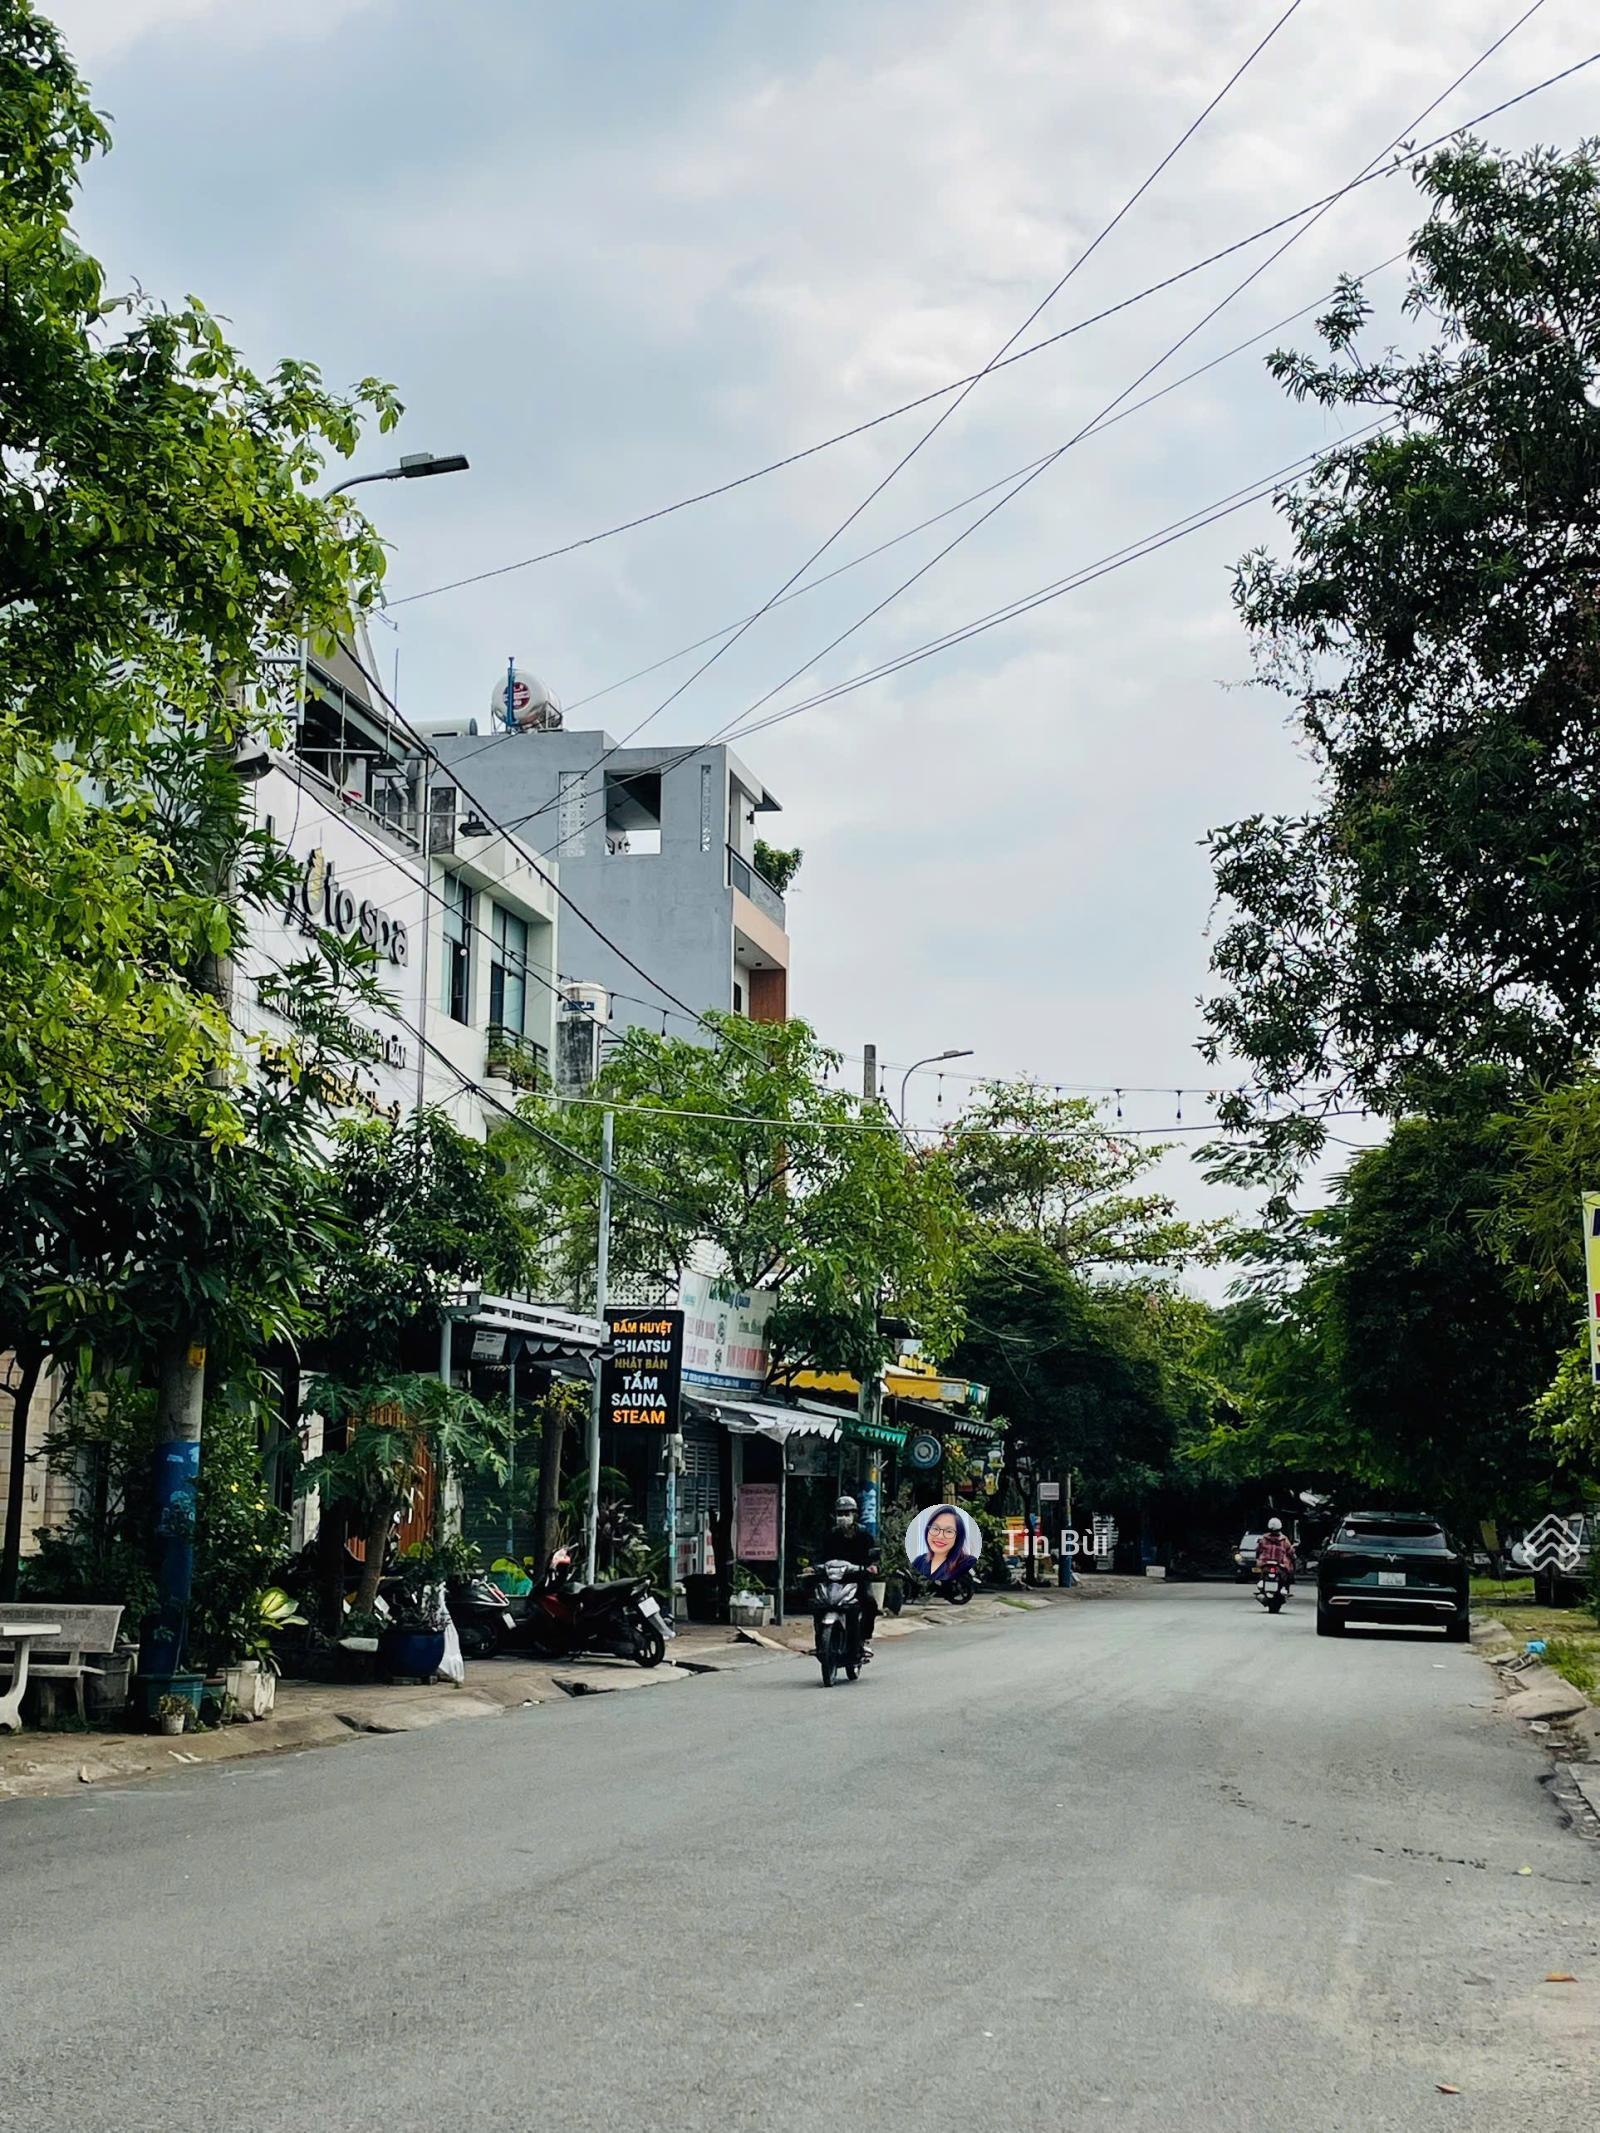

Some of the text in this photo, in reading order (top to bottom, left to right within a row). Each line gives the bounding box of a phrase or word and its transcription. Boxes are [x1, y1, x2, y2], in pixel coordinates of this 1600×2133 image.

[613, 1318, 637, 1333] BẤM
[639, 1320, 673, 1336] HUYỆT
[613, 1339, 671, 1353] SHIATSU
[614, 1356, 643, 1371] NHẬT
[645, 1355, 668, 1370] BẢN
[611, 1393, 668, 1408] SAUNA
[612, 1410, 666, 1425] STEAM
